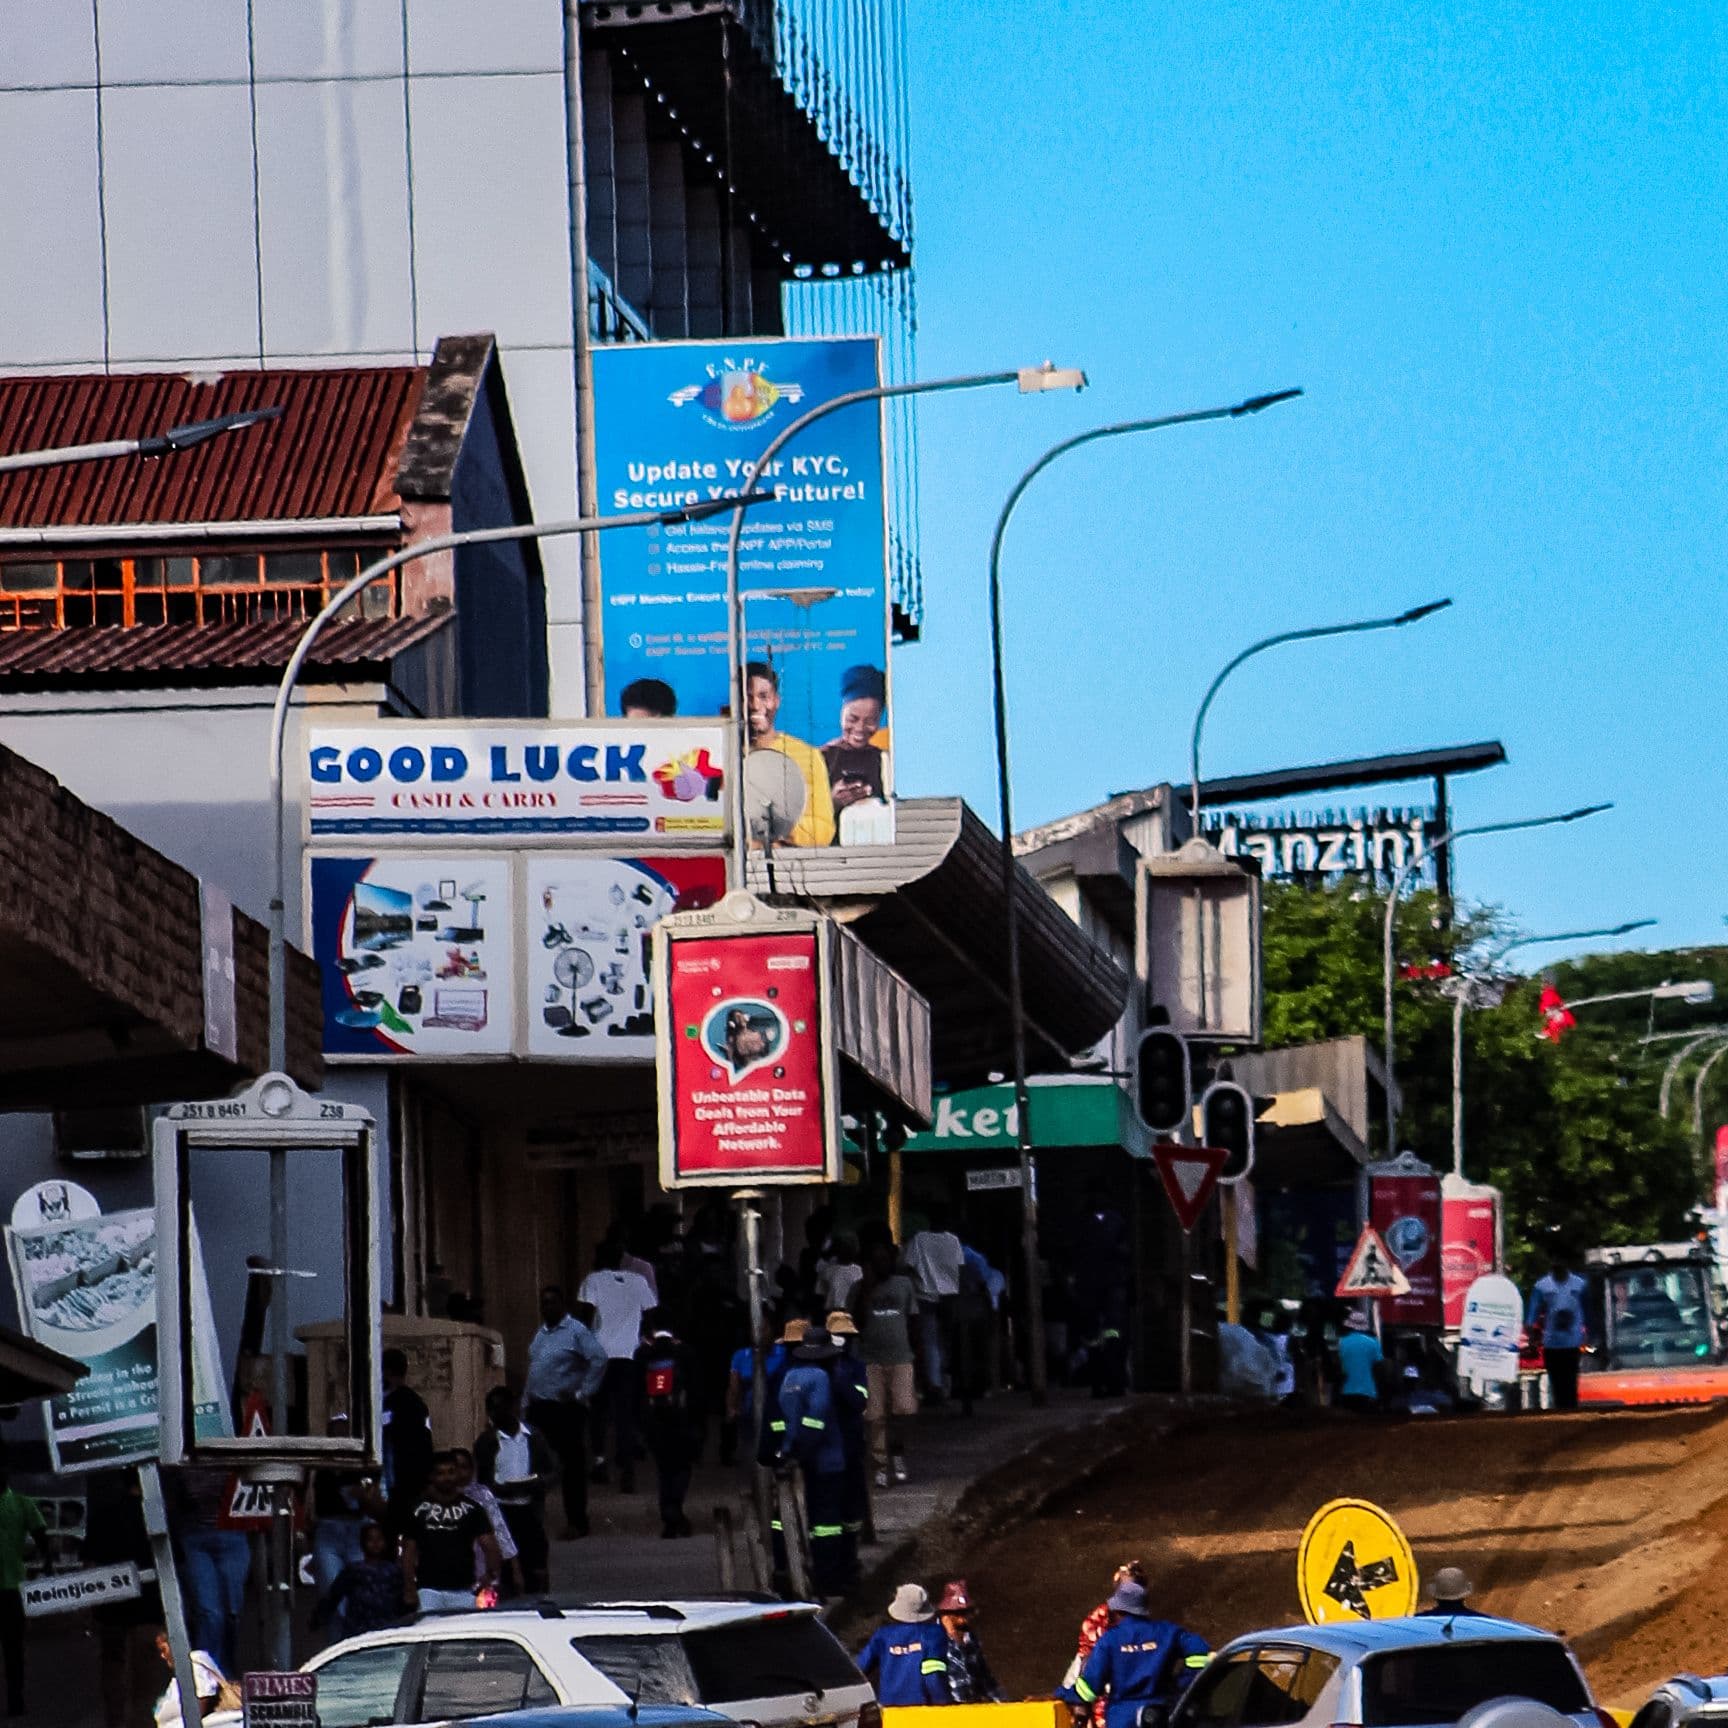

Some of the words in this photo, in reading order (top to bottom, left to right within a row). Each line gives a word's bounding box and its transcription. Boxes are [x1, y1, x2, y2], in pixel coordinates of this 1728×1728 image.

[628, 459, 717, 484] Update
[725, 458, 783, 478] Your
[792, 456, 849, 478] KYC,
[614, 488, 699, 508] Secure
[773, 481, 866, 502] Future!
[310, 746, 469, 783] GOOD
[490, 745, 646, 783] LUCK
[392, 793, 452, 809] CASH
[459, 793, 475, 808] &
[484, 792, 560, 809] CARRY
[692, 1089, 770, 1104] Unbeatable
[772, 1088, 806, 1102] Data
[695, 1106, 734, 1121] Deals
[735, 1106, 770, 1119] from
[771, 1105, 804, 1117] Your
[930, 1097, 1020, 1138] ket
[711, 1121, 787, 1136] Affordable
[718, 1136, 782, 1152] Network.
[69, 1402, 111, 1418] Permit
[414, 1501, 475, 1522] PRADA
[110, 1574, 132, 1589] St
[248, 1676, 313, 1697] TIMES
[250, 1703, 314, 1721] SCRAMBLE
